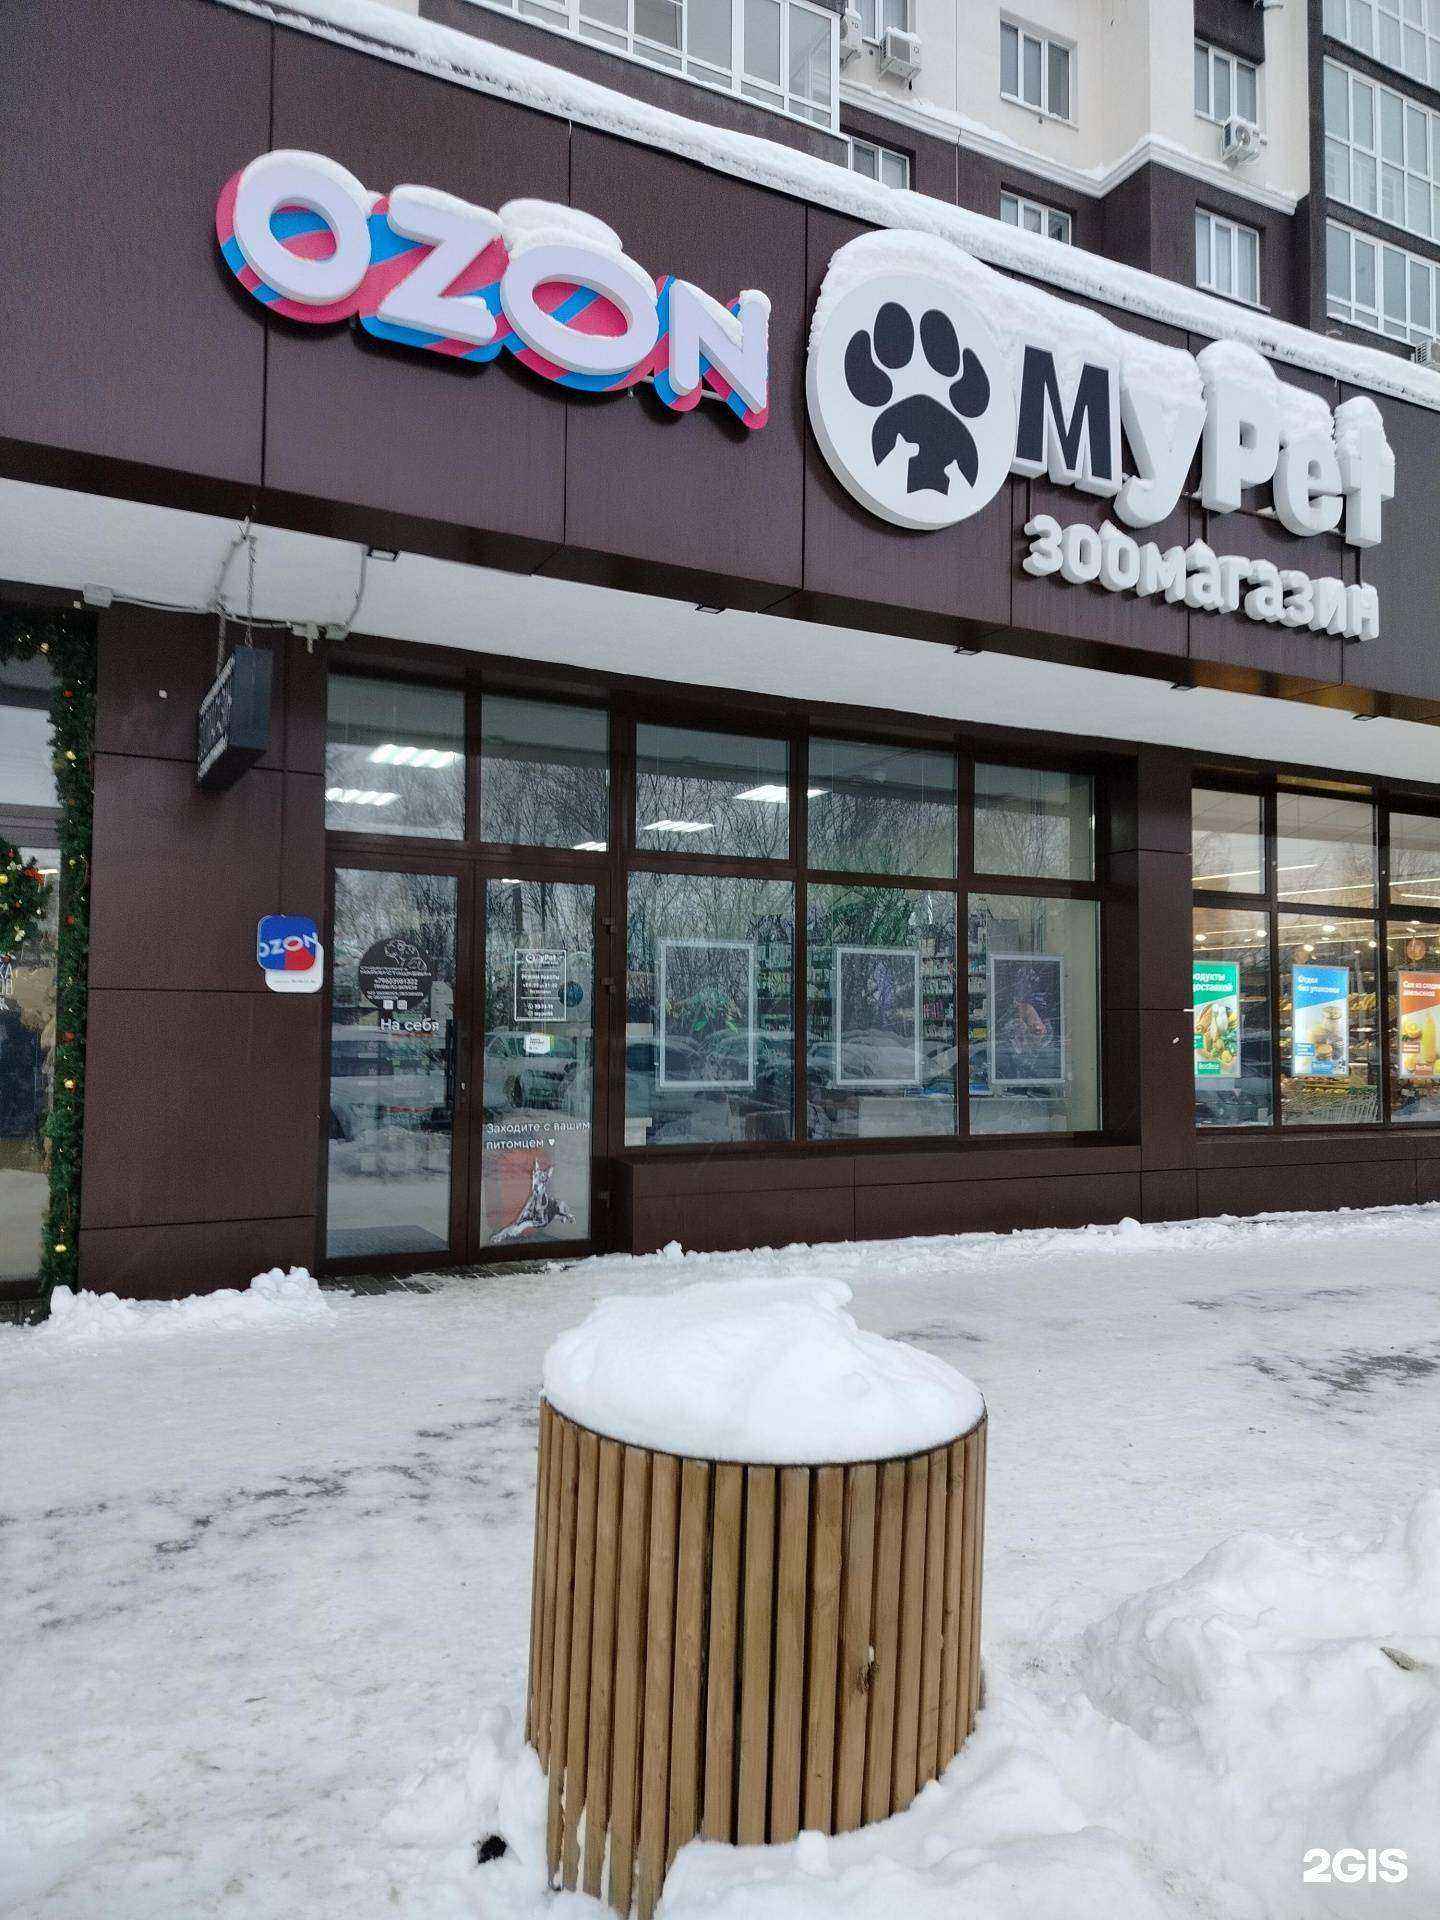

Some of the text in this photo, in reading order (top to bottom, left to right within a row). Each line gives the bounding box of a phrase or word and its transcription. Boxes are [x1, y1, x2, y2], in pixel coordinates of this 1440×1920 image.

[218, 149, 772, 428] OZON
[1023, 515, 1380, 642] зоомагазин
[258, 932, 319, 958] OZON
[380, 1015, 440, 1032] На себя
[486, 1122, 541, 1134] Заходите
[486, 1139, 544, 1150] питомцем
